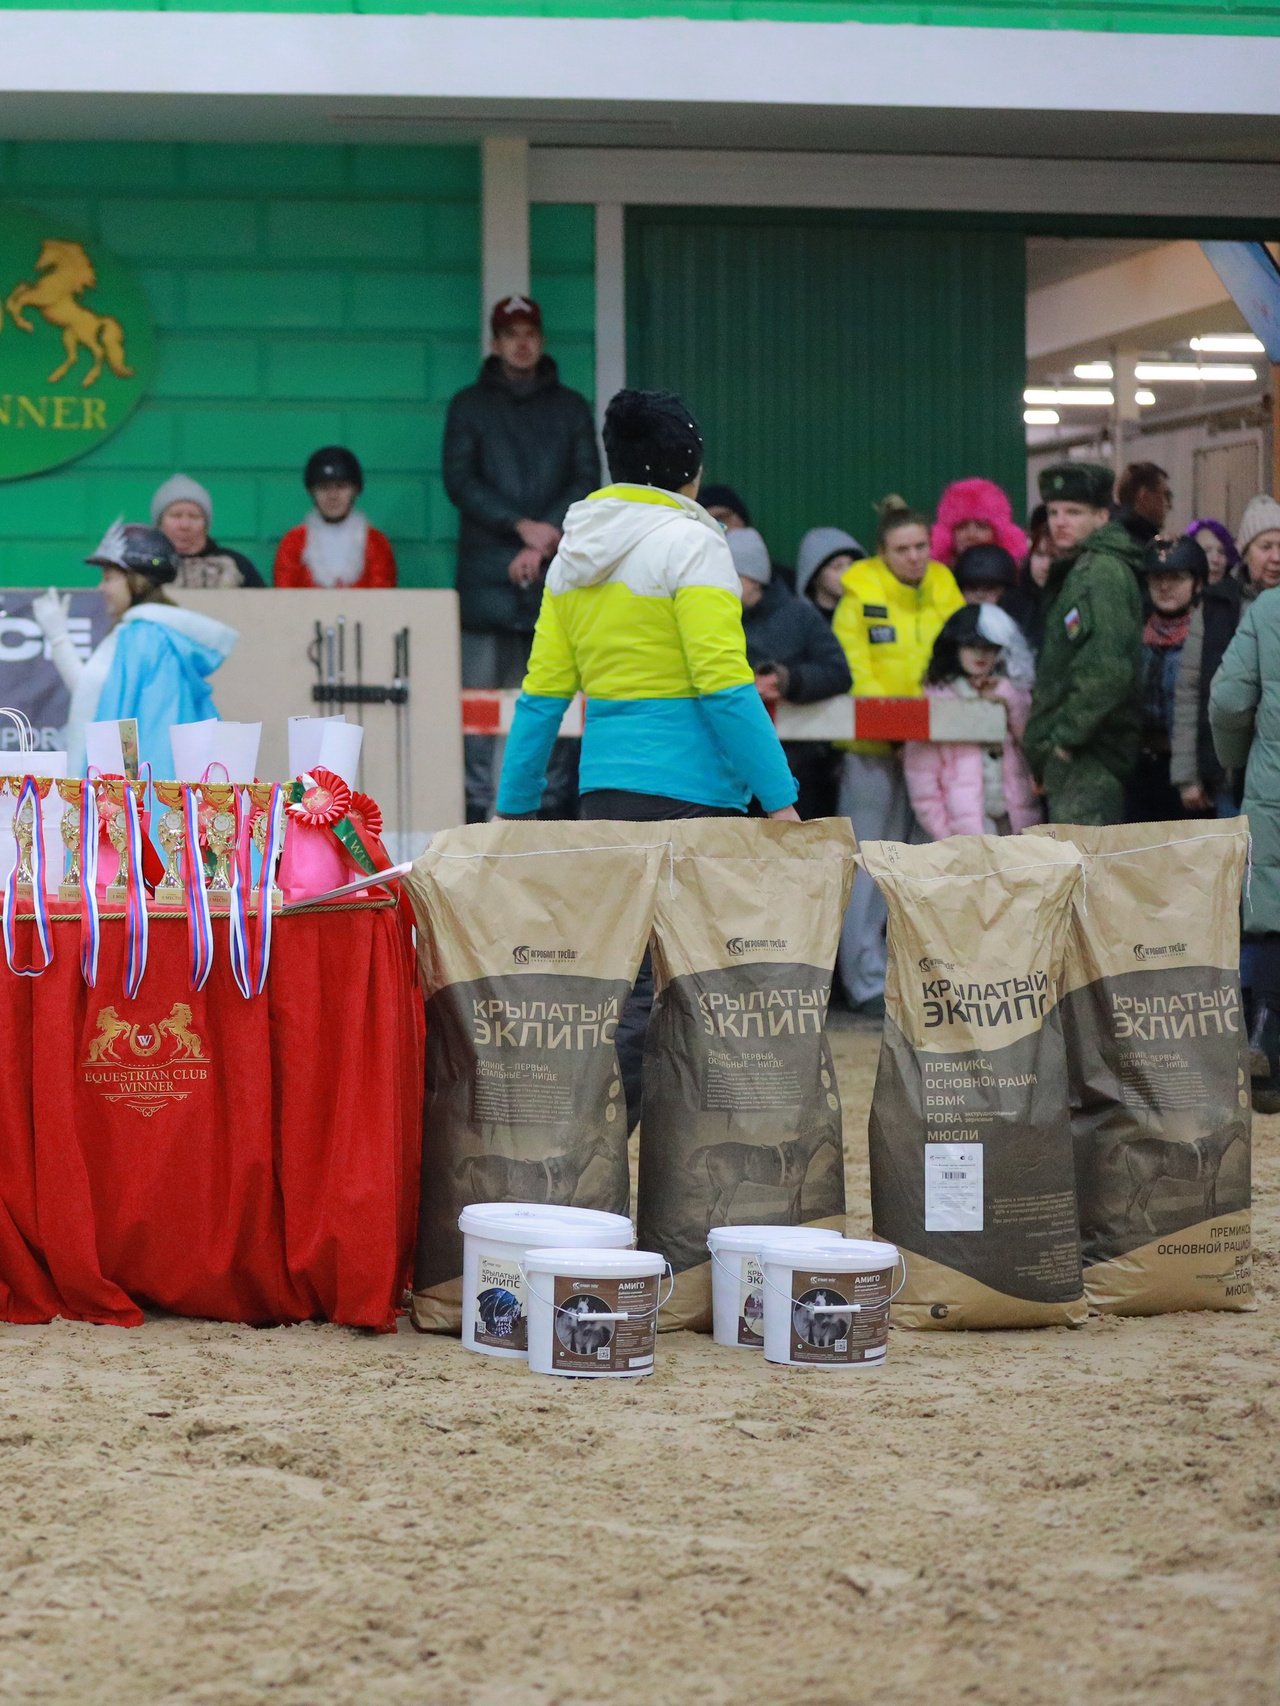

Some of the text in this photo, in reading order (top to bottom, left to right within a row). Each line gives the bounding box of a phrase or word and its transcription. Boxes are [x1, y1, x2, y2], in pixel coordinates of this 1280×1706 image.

[530, 950, 556, 958] АГРОБАЛТ
[695, 986, 831, 1010] КРЫЛАТЫЙ
[1112, 985, 1238, 1014] КРЫЛАТЫЙ
[473, 996, 618, 1022] КРЫЛАТЫЙ
[700, 1008, 827, 1038] ЭКЛИП
[1112, 1007, 1239, 1041] ЭКЛИПС
[473, 1018, 619, 1050] ЭКЛИПС
[137, 1035, 152, 1047] W
[741, 1051, 777, 1060] ПЕРВЫЙ,
[476, 1060, 504, 1071] ЭКЛИПС
[515, 1063, 551, 1073] ПЕРВЫЙ,
[708, 1057, 748, 1068] ОСЛЬНЫЕ
[758, 1060, 784, 1068] НИГДЕ
[1166, 1061, 1189, 1069] НИГДЕ
[85, 1069, 207, 1083] EQUESTRIAN CLUB
[476, 1068, 520, 1079] ОСТАЛЬНЫЕ
[532, 1073, 558, 1081] НИГДЕ
[119, 1081, 174, 1093] WINNER
[925, 1074, 1038, 1089] ОСНОВНОЙ РАЦИН
[926, 1095, 965, 1106] БВМК
[927, 1112, 962, 1123] FORA
[927, 1130, 979, 1141] МЮСЛИ
[1210, 1224, 1251, 1238] ПРЕМИКС
[1158, 1239, 1250, 1255] ОСНОВНОЙ РАЦИО
[482, 1269, 520, 1280] КРЫЛАТЫЙ
[855, 1275, 880, 1284] АМИГО
[1235, 1268, 1251, 1279] FOR
[482, 1274, 521, 1288] ЭКЛИПС
[618, 1282, 645, 1290] АМИГО
